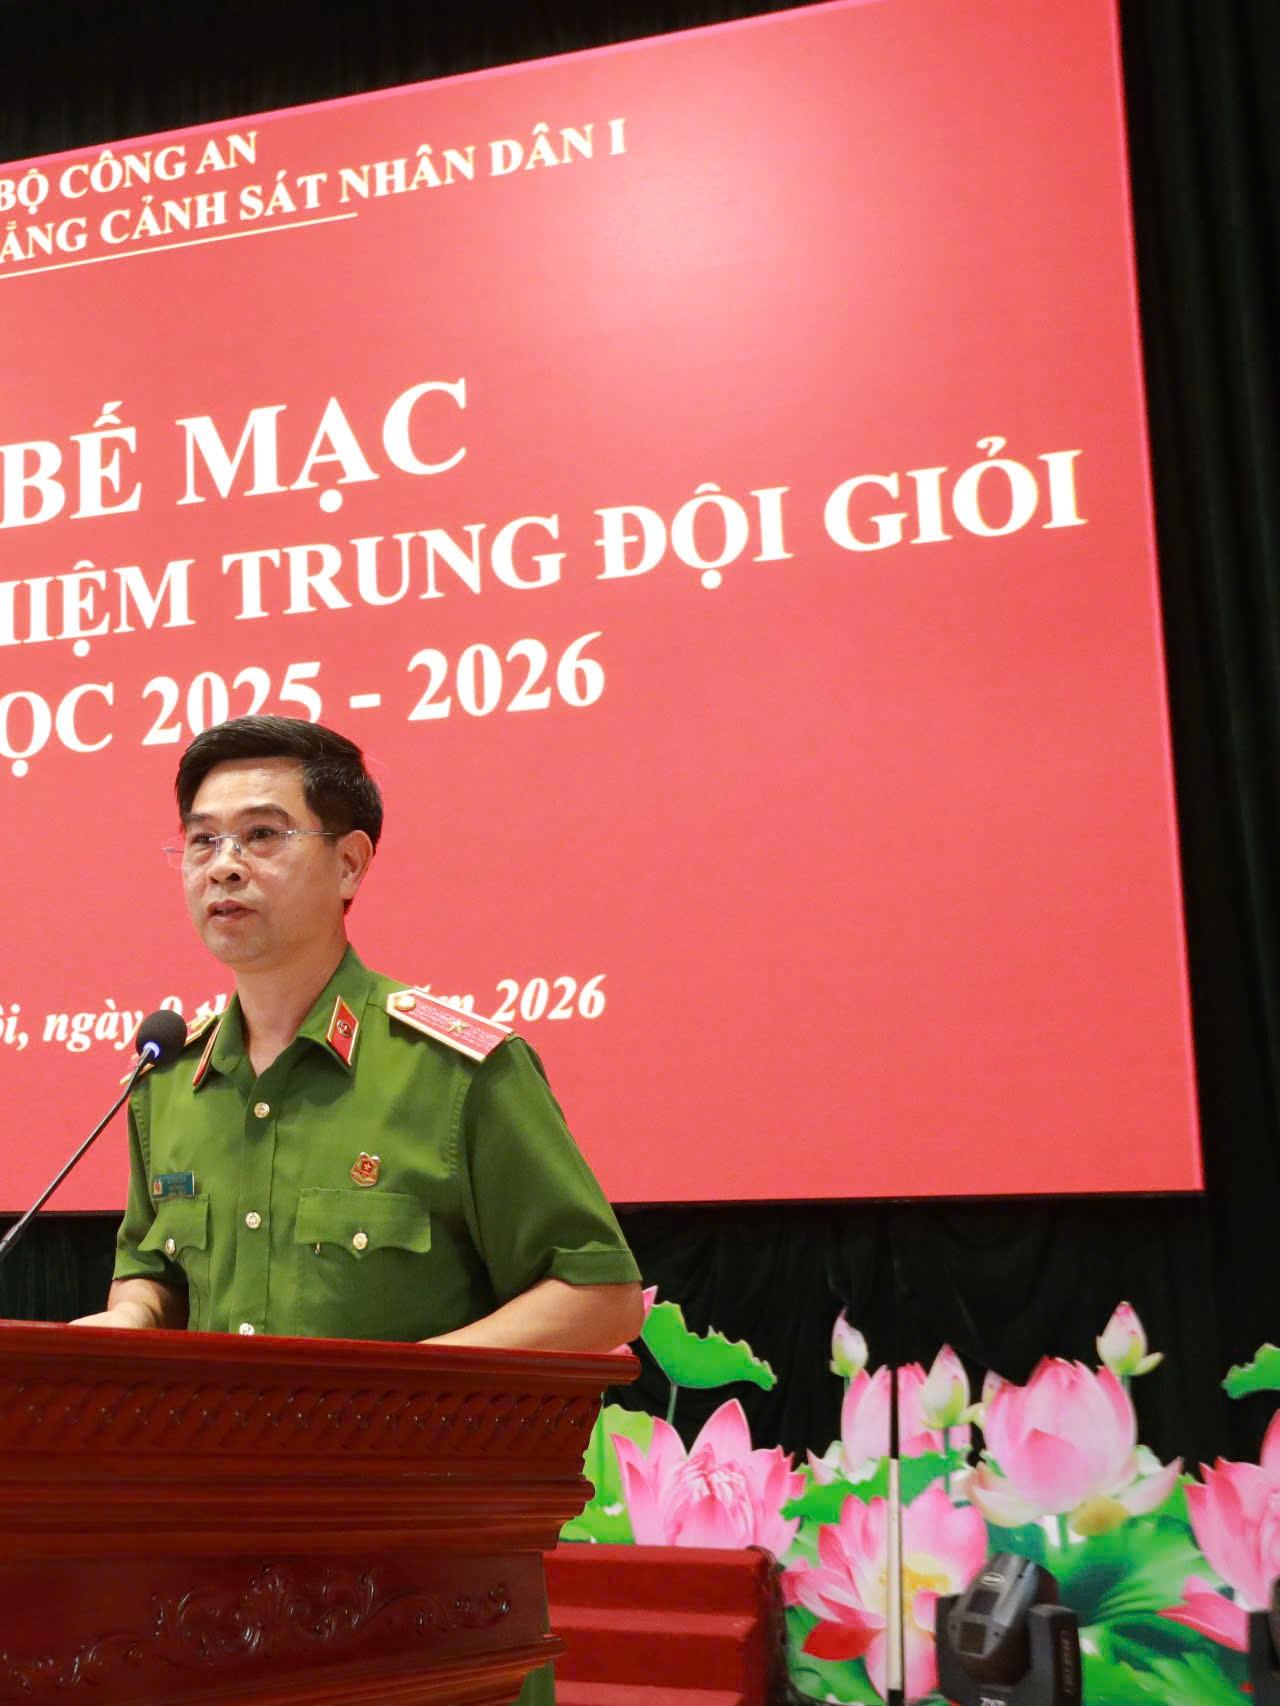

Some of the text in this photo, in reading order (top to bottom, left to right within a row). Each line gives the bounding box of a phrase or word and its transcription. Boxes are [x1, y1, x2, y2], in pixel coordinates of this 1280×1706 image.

[59, 145, 187, 199] CÔNG
[195, 130, 259, 175] AN
[100, 191, 227, 244] CẢNH
[239, 170, 328, 221] SÁT
[339, 144, 475, 203] NHÂN
[489, 123, 593, 177] DÂN
[609, 118, 627, 156] I
[175, 377, 466, 513] MẠC
[222, 514, 565, 620] TRUNG
[594, 483, 792, 590] ĐỘI
[824, 436, 1086, 552] GIỎI
[141, 661, 323, 746] 2025
[348, 693, 382, 710] -
[407, 631, 605, 721] 2026
[42, 998, 144, 1053] ngày
[492, 974, 607, 1023] 2026
